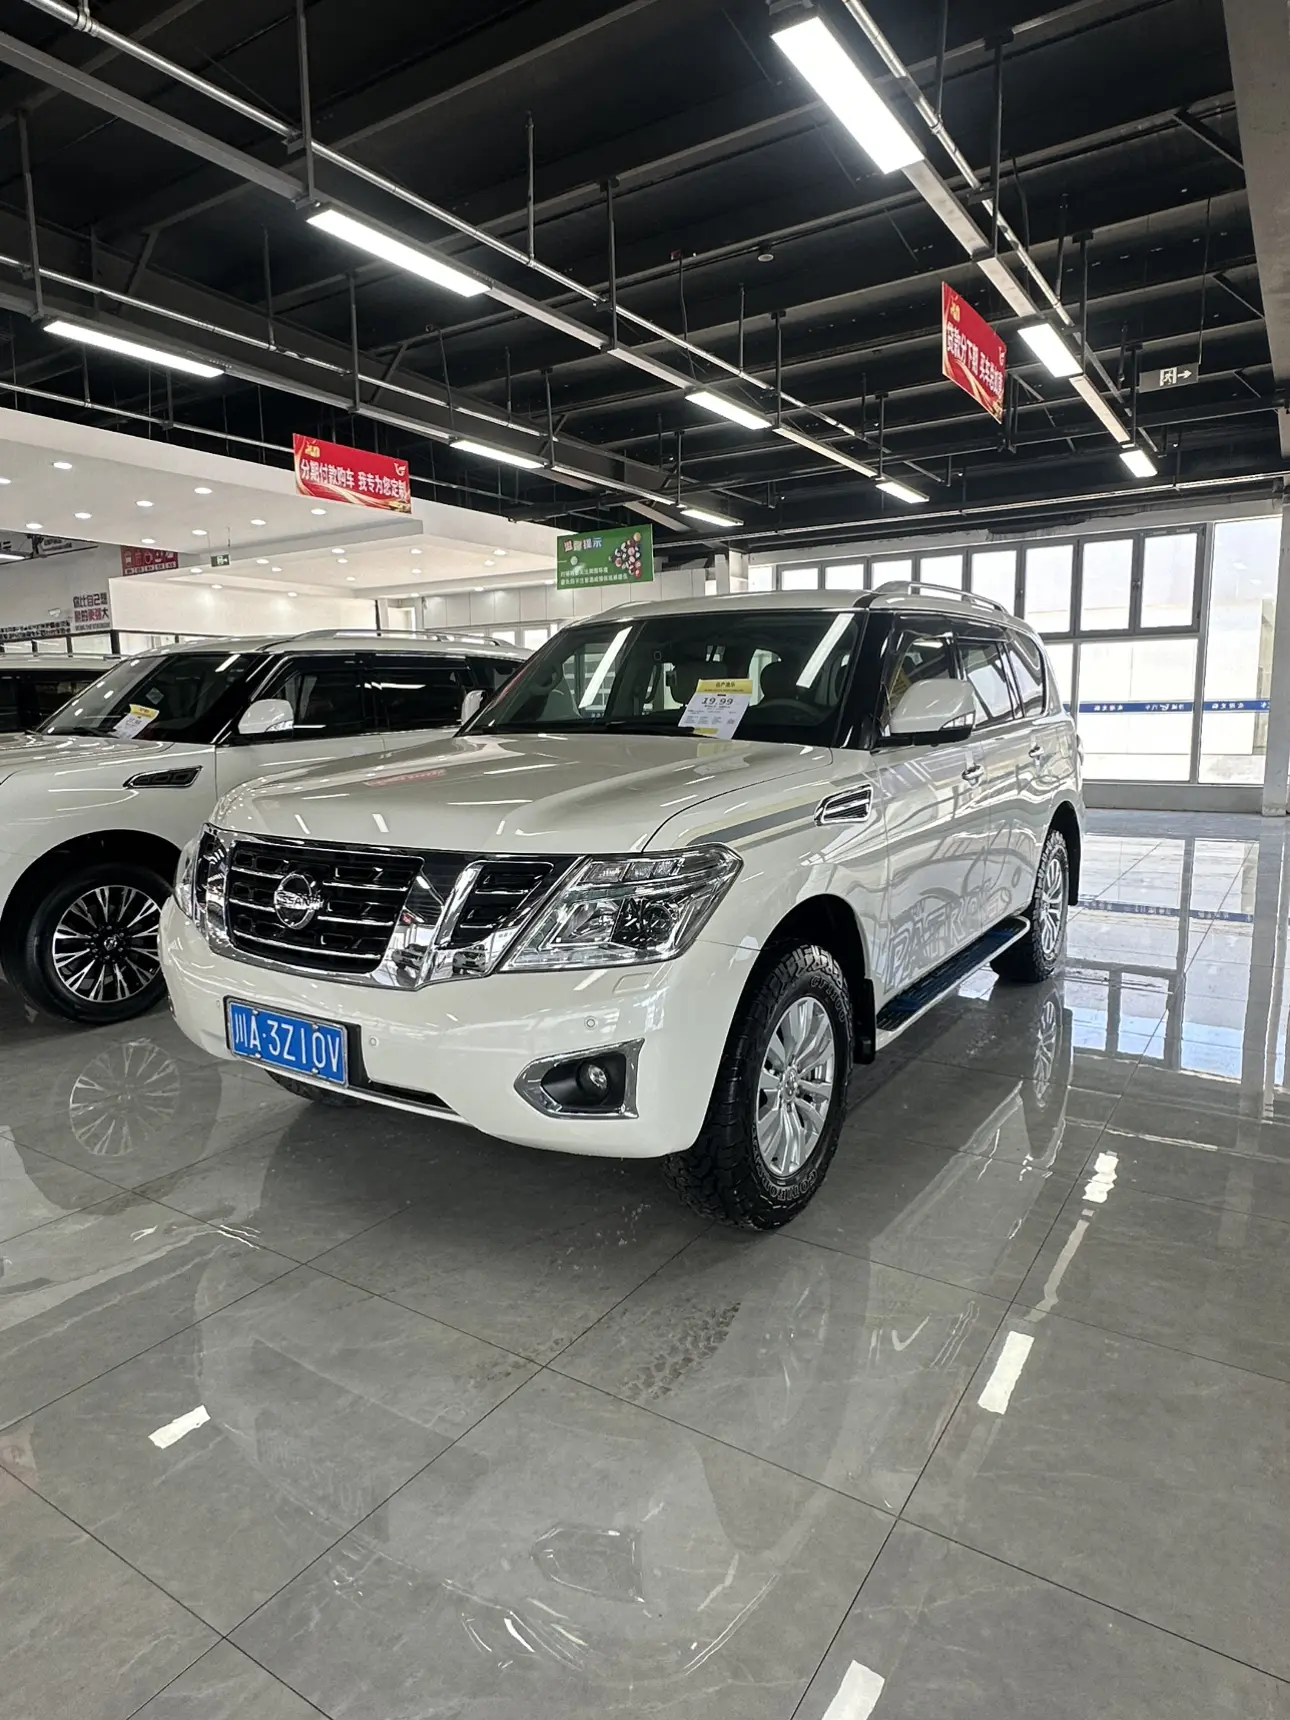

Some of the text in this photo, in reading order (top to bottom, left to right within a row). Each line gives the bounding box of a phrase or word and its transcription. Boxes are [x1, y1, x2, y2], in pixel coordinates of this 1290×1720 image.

[301, 459, 407, 500] 分期付款购车 我专为您定制
[701, 697, 733, 706] 19.99
